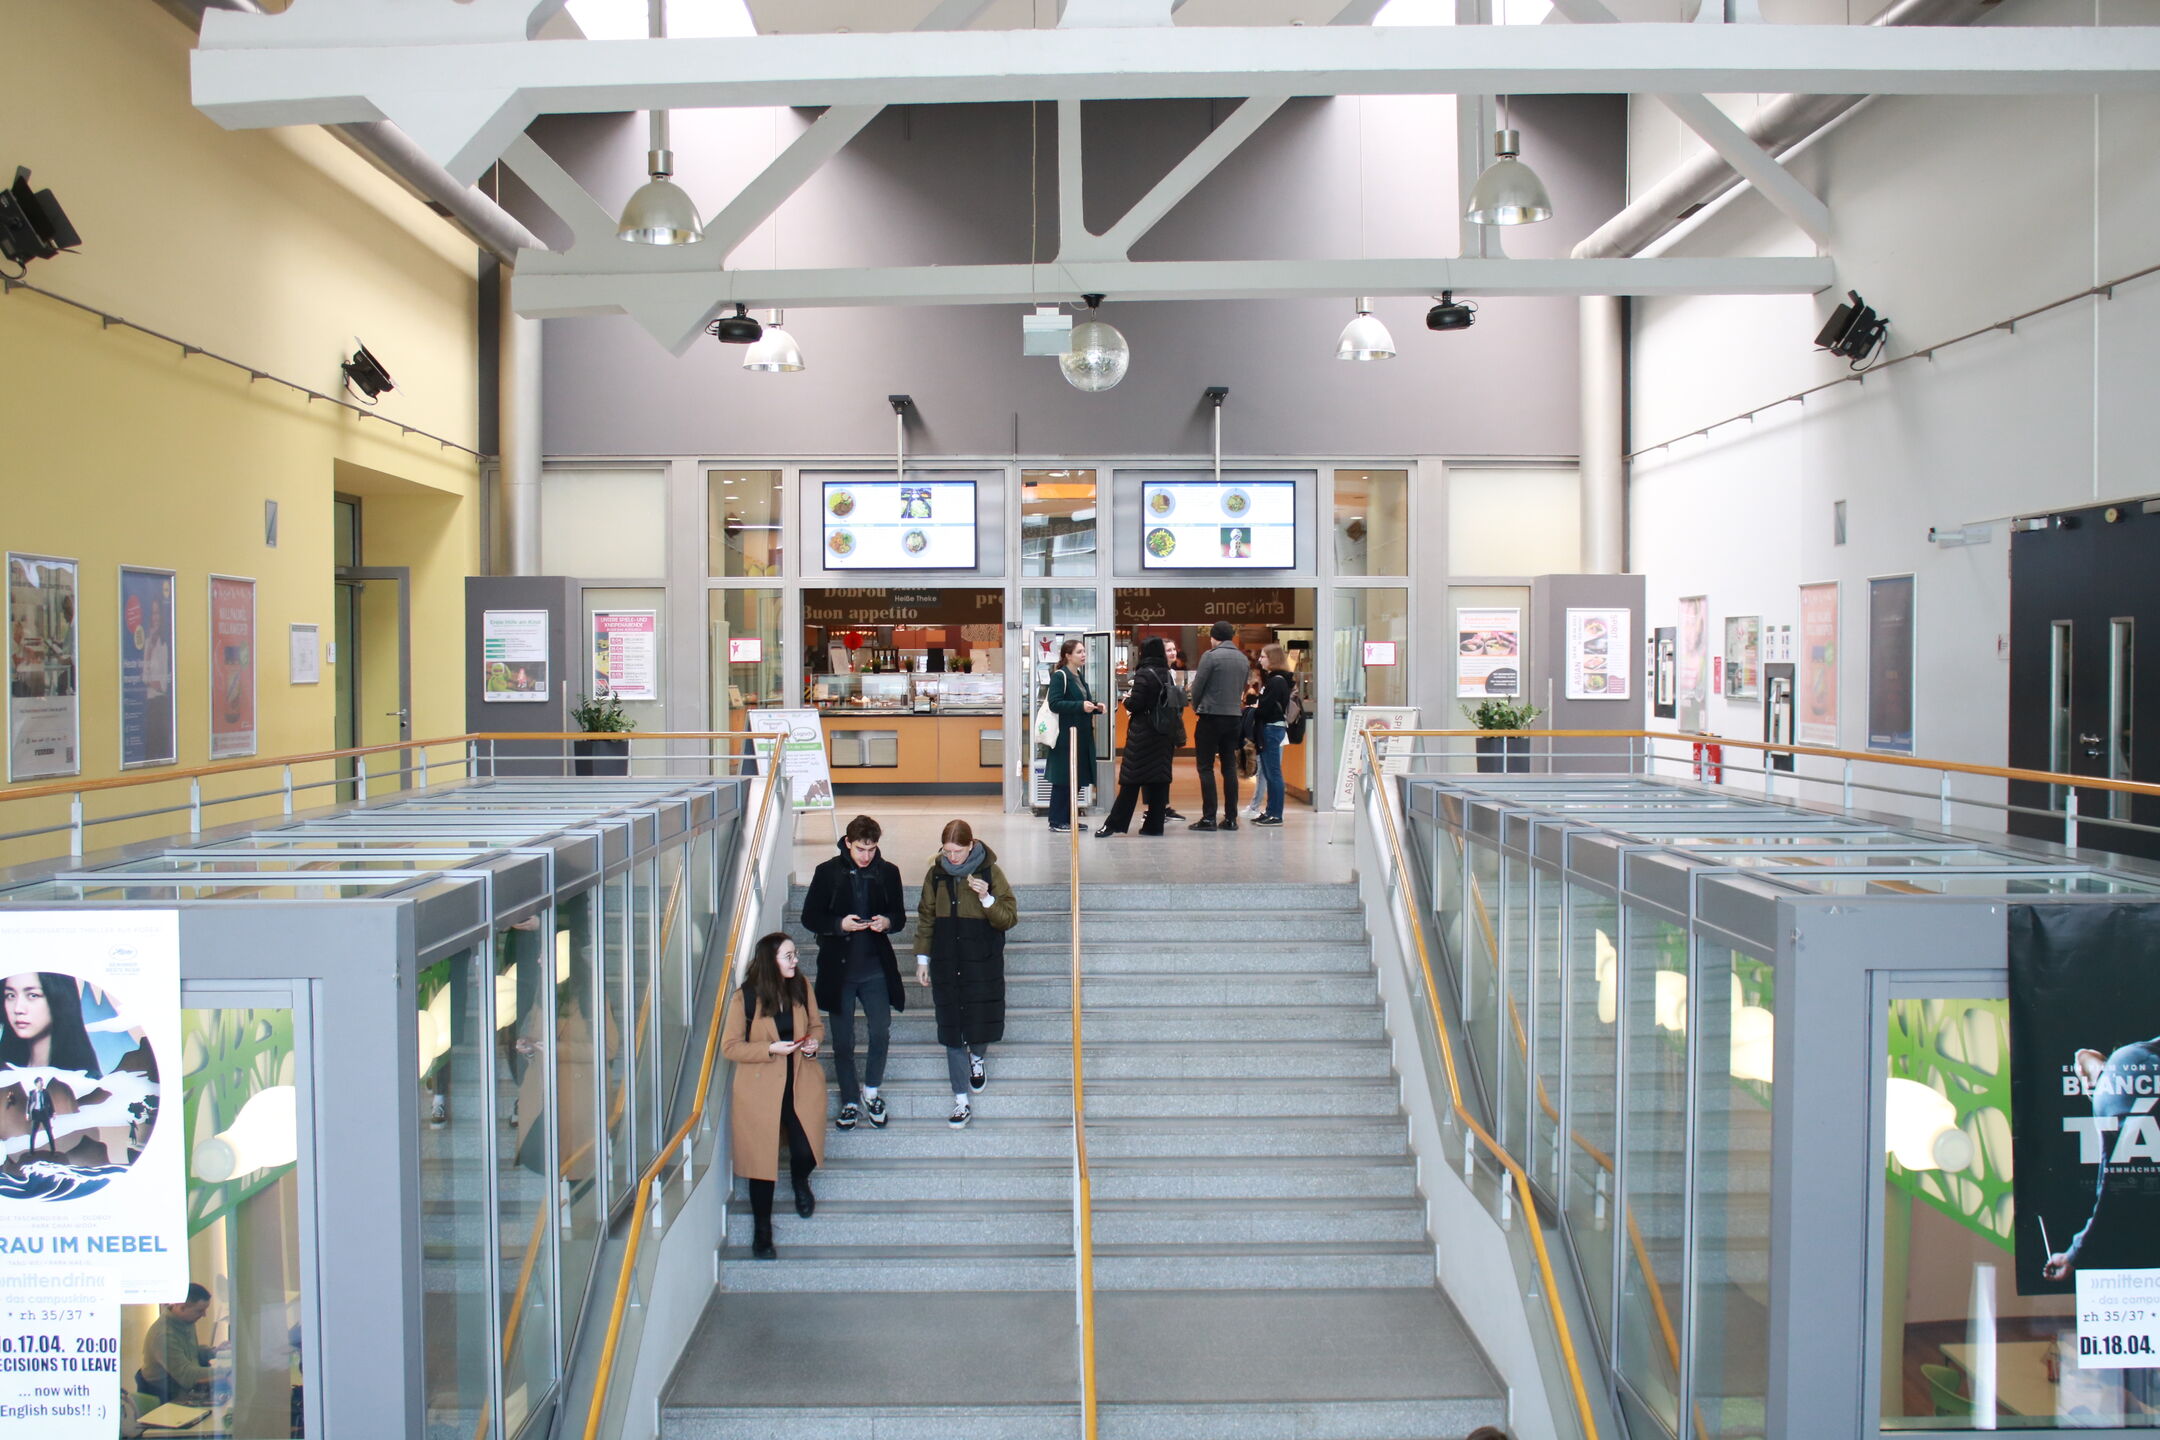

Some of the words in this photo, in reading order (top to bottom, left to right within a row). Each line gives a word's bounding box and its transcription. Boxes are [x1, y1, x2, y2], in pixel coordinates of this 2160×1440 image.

[916, 594, 937, 602] Theke
[849, 606, 918, 623] appetito
[0, 1237, 44, 1253] RAU
[52, 1236, 79, 1253] IM
[88, 1236, 168, 1252] NEBEL
[6, 1294, 25, 1304] das
[28, 1293, 97, 1306] campuskino
[2099, 1295, 2119, 1305] das
[20, 1310, 36, 1320] rh
[42, 1310, 82, 1321] 35/37
[2083, 1311, 2099, 1322] rh
[2104, 1311, 2144, 1322] 35/37
[76, 1338, 117, 1353] 20:00
[61, 1358, 78, 1372] TO
[82, 1358, 117, 1372] LEAVE
[35, 1387, 60, 1397] now
[63, 1384, 90, 1396] with
[0, 1404, 48, 1419] English
[52, 1404, 91, 1416] subs!!
